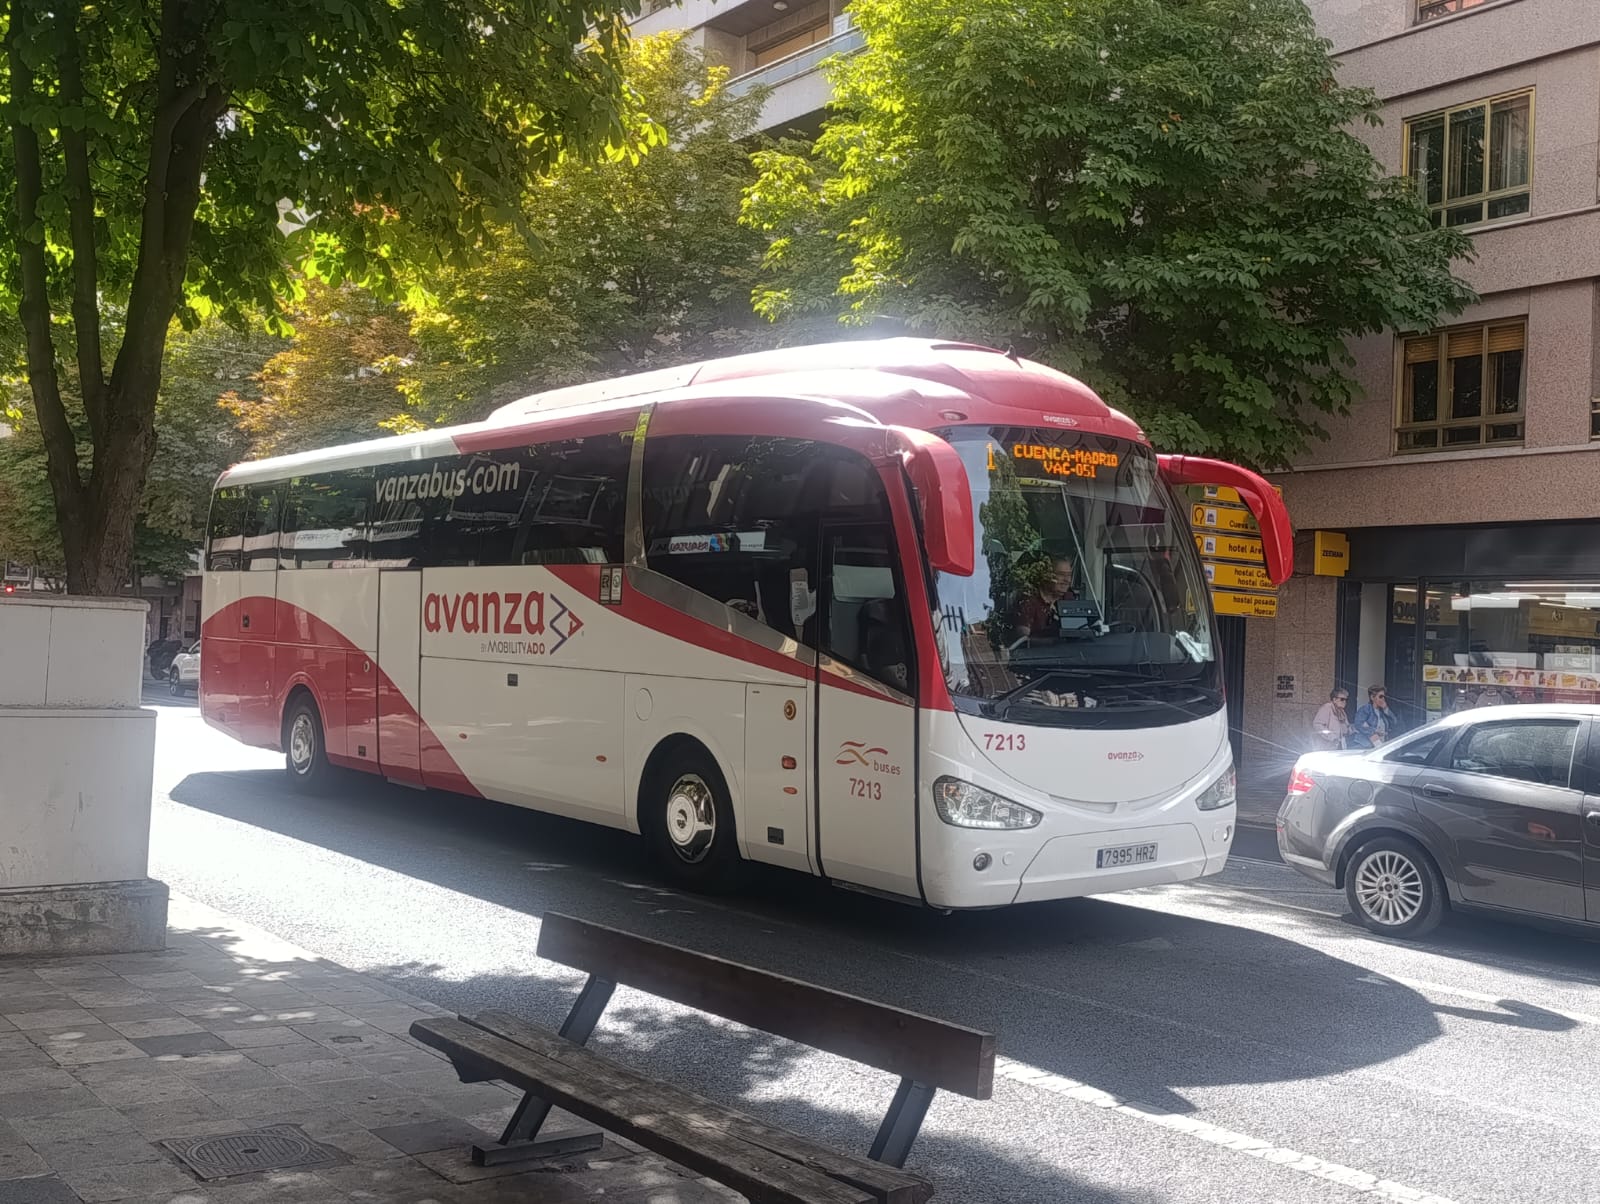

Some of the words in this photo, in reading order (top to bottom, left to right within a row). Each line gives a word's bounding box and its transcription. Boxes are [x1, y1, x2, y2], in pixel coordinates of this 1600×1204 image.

[986, 442, 997, 470] 1
[1013, 444, 1119, 468] CUENCA-MADRID
[1043, 460, 1097, 478] VAC-051
[375, 461, 520, 503] vanzabus.com
[1228, 543, 1247, 553] hotel
[1234, 568, 1254, 577] hostal
[1238, 578, 1257, 587] hostal
[1233, 595, 1252, 604] hostal
[424, 590, 546, 635] avanza
[983, 734, 1026, 751] 7213
[1107, 751, 1137, 760] avanza
[849, 778, 882, 800] 7213
[1105, 848, 1132, 865] 7995
[1135, 845, 1156, 862] HRZ
